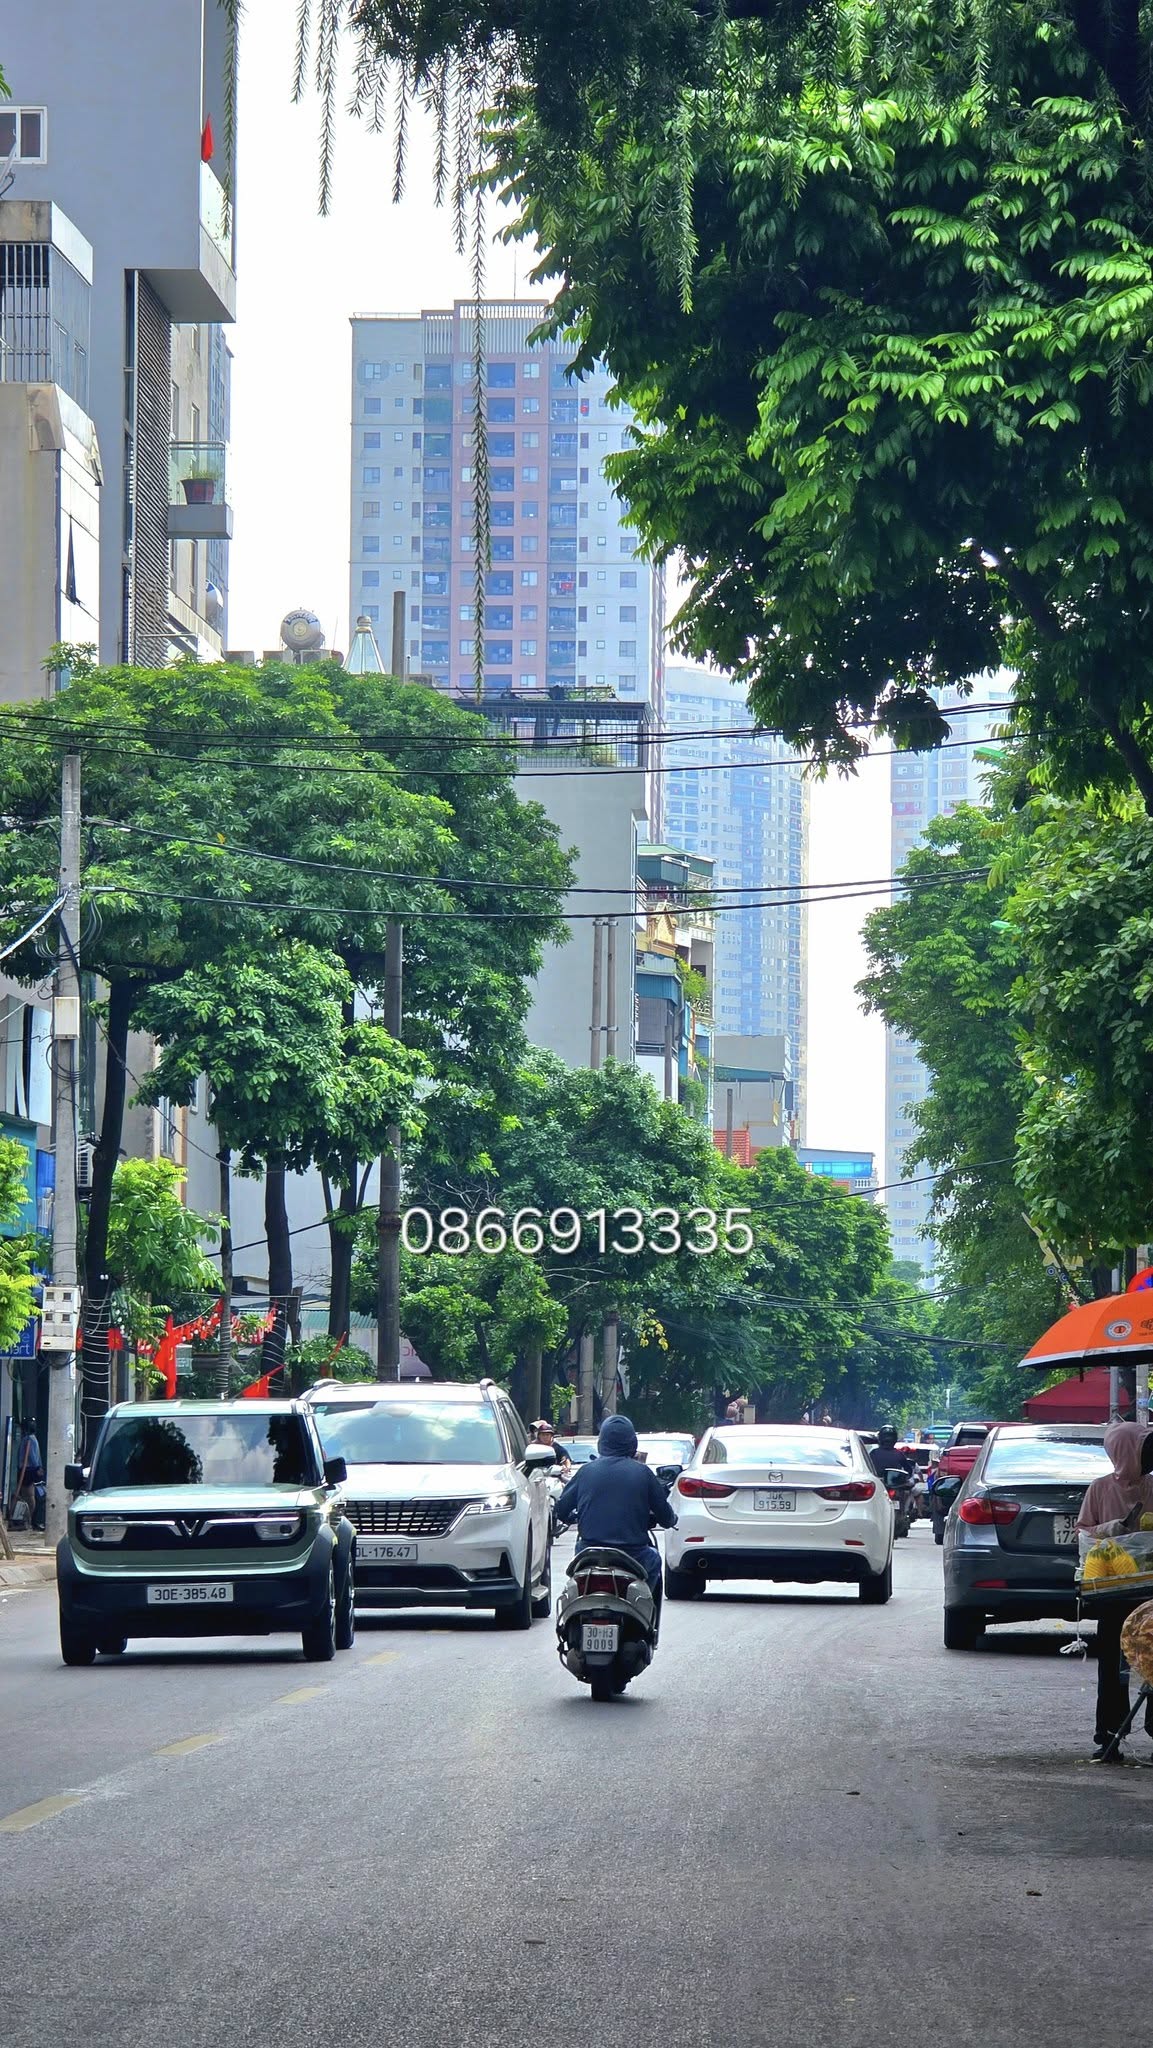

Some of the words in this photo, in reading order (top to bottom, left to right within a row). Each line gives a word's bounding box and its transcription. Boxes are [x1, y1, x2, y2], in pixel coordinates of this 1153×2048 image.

[759, 1501, 791, 1510] 915.59
[154, 1587, 226, 1601] 30E-385.48
[587, 1639, 613, 1650] 9009
